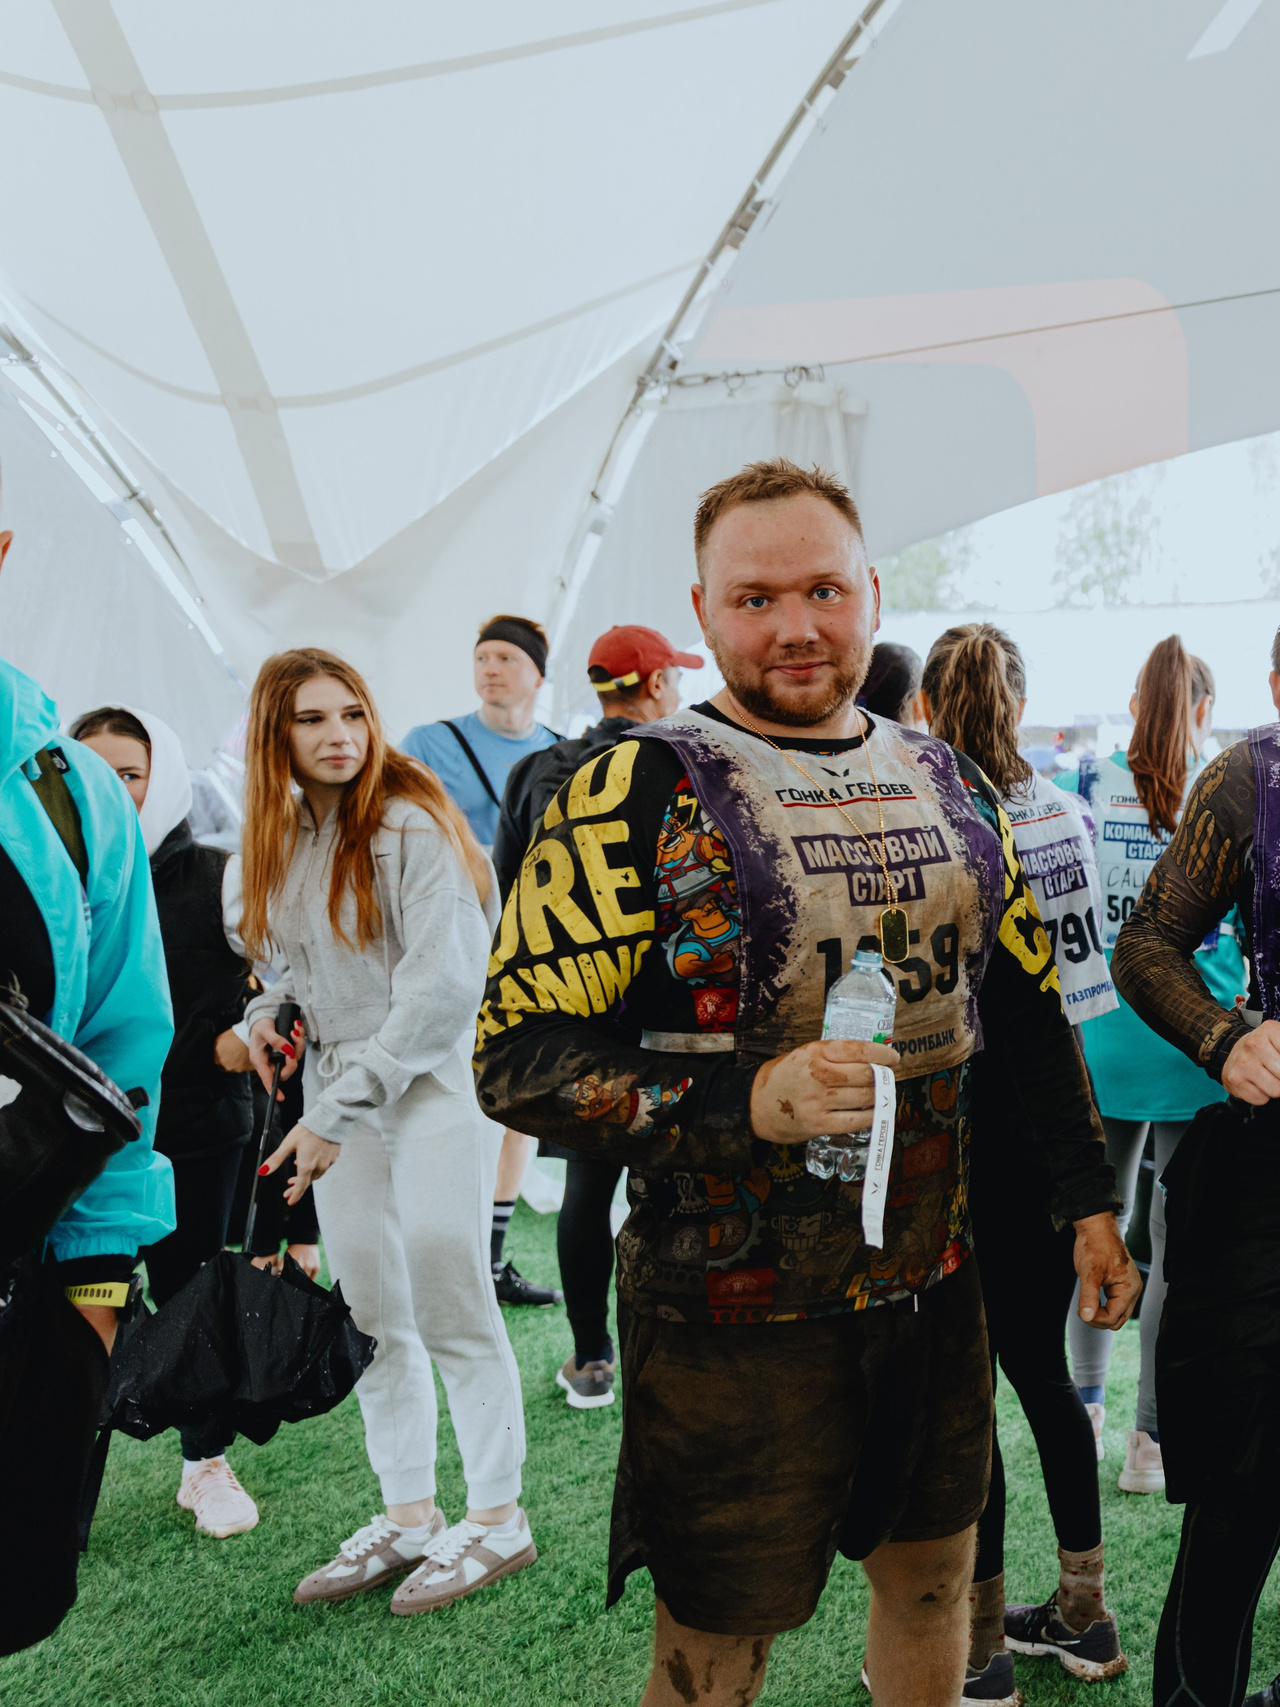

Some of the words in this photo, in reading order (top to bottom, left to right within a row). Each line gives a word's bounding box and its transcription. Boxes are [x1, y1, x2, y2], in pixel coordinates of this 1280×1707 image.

[775, 788, 843, 802] ГОНКА
[845, 782, 913, 797] ГЕРОЕВ
[1007, 808, 1035, 822] ОНКА
[800, 826, 944, 869] МАССОВЫЙ
[852, 868, 917, 902] СТАРТ
[1044, 866, 1084, 897] СТАРТ
